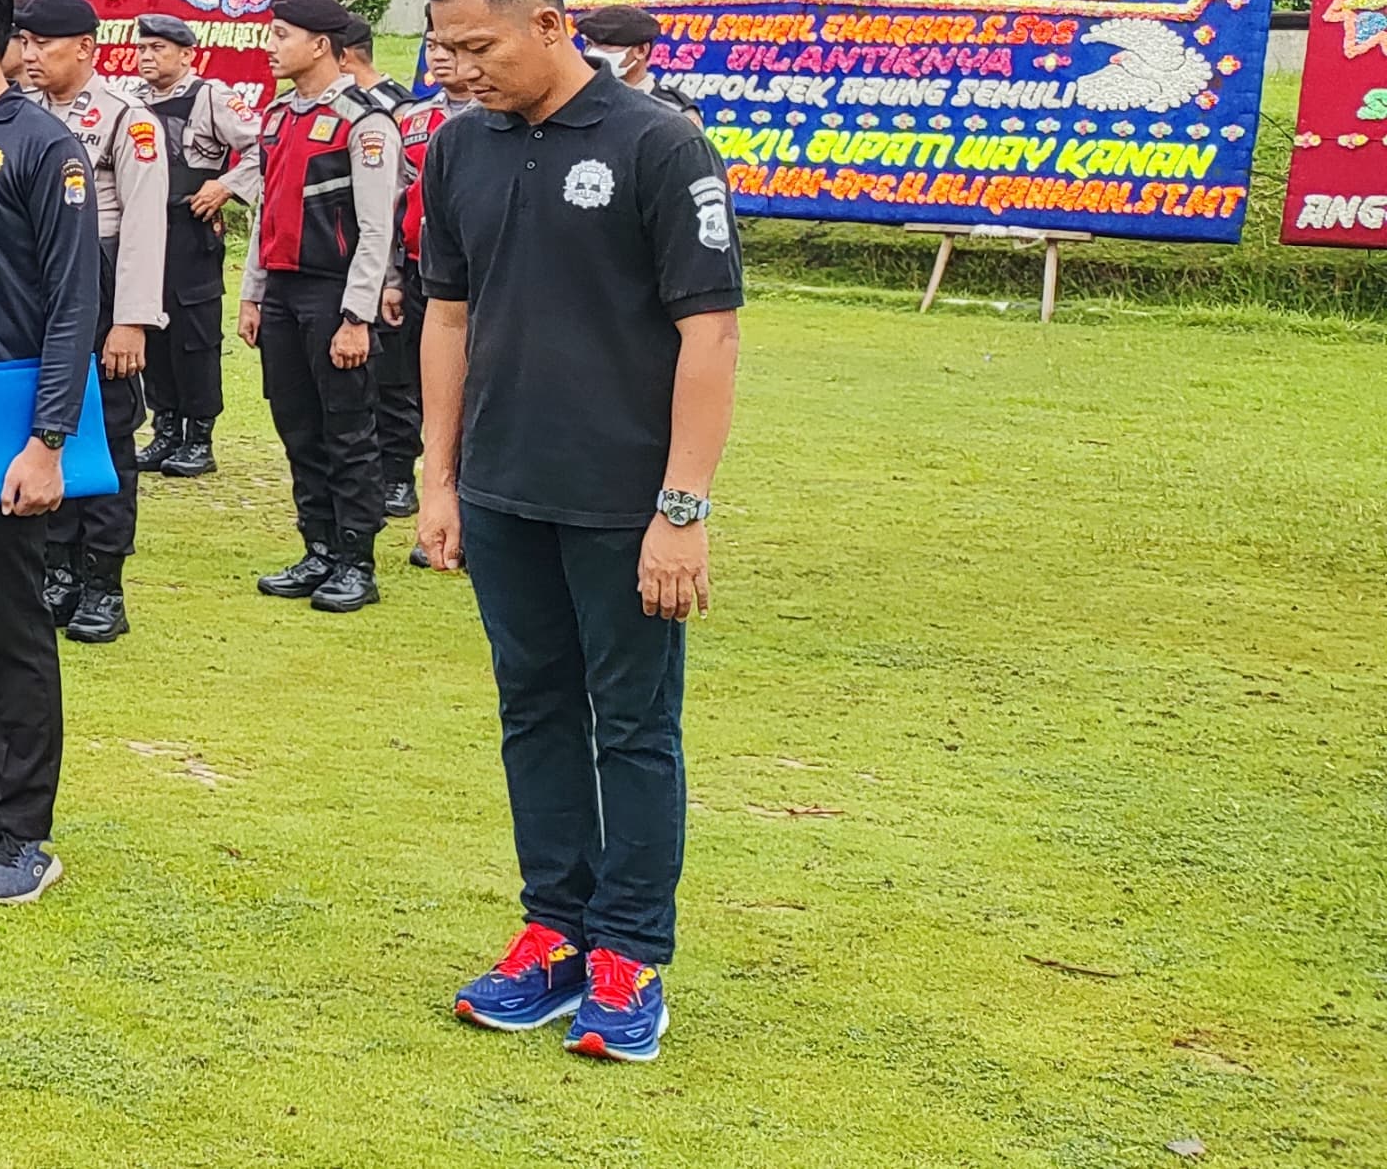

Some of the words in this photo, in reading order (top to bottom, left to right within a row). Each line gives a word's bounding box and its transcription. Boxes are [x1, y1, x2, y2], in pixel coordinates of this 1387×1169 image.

[950, 80, 1076, 108] SEMULI
[805, 129, 955, 168] BUPATI
[954, 134, 1057, 172] WAY
[1055, 138, 1218, 180] KANAN
